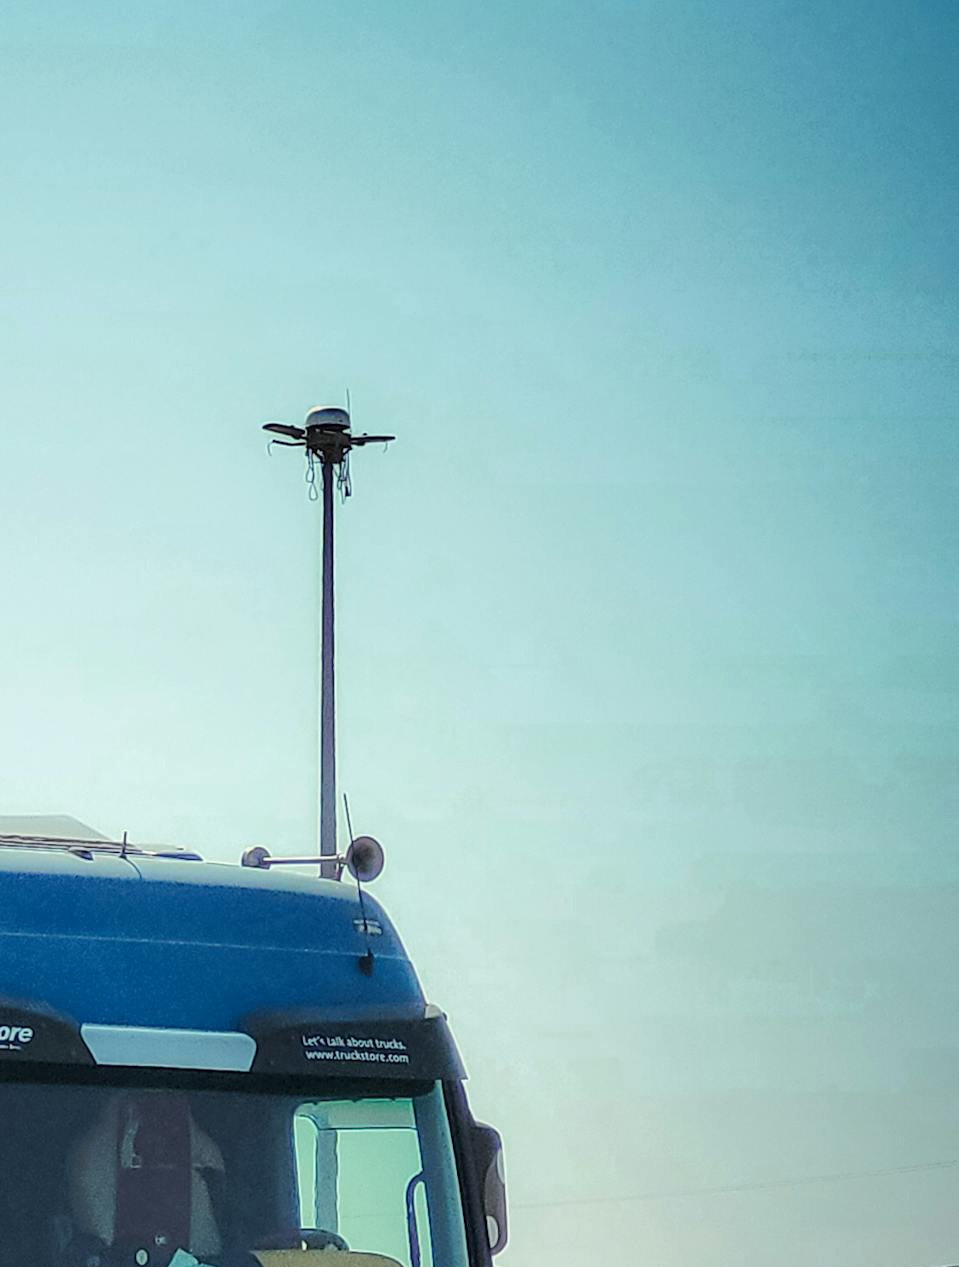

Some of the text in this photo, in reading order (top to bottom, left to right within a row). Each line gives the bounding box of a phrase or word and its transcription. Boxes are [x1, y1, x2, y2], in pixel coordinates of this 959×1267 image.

[326, 1036, 345, 1047] talk
[346, 1037, 374, 1048] about
[305, 1050, 409, 1063] www.truckstore.com
